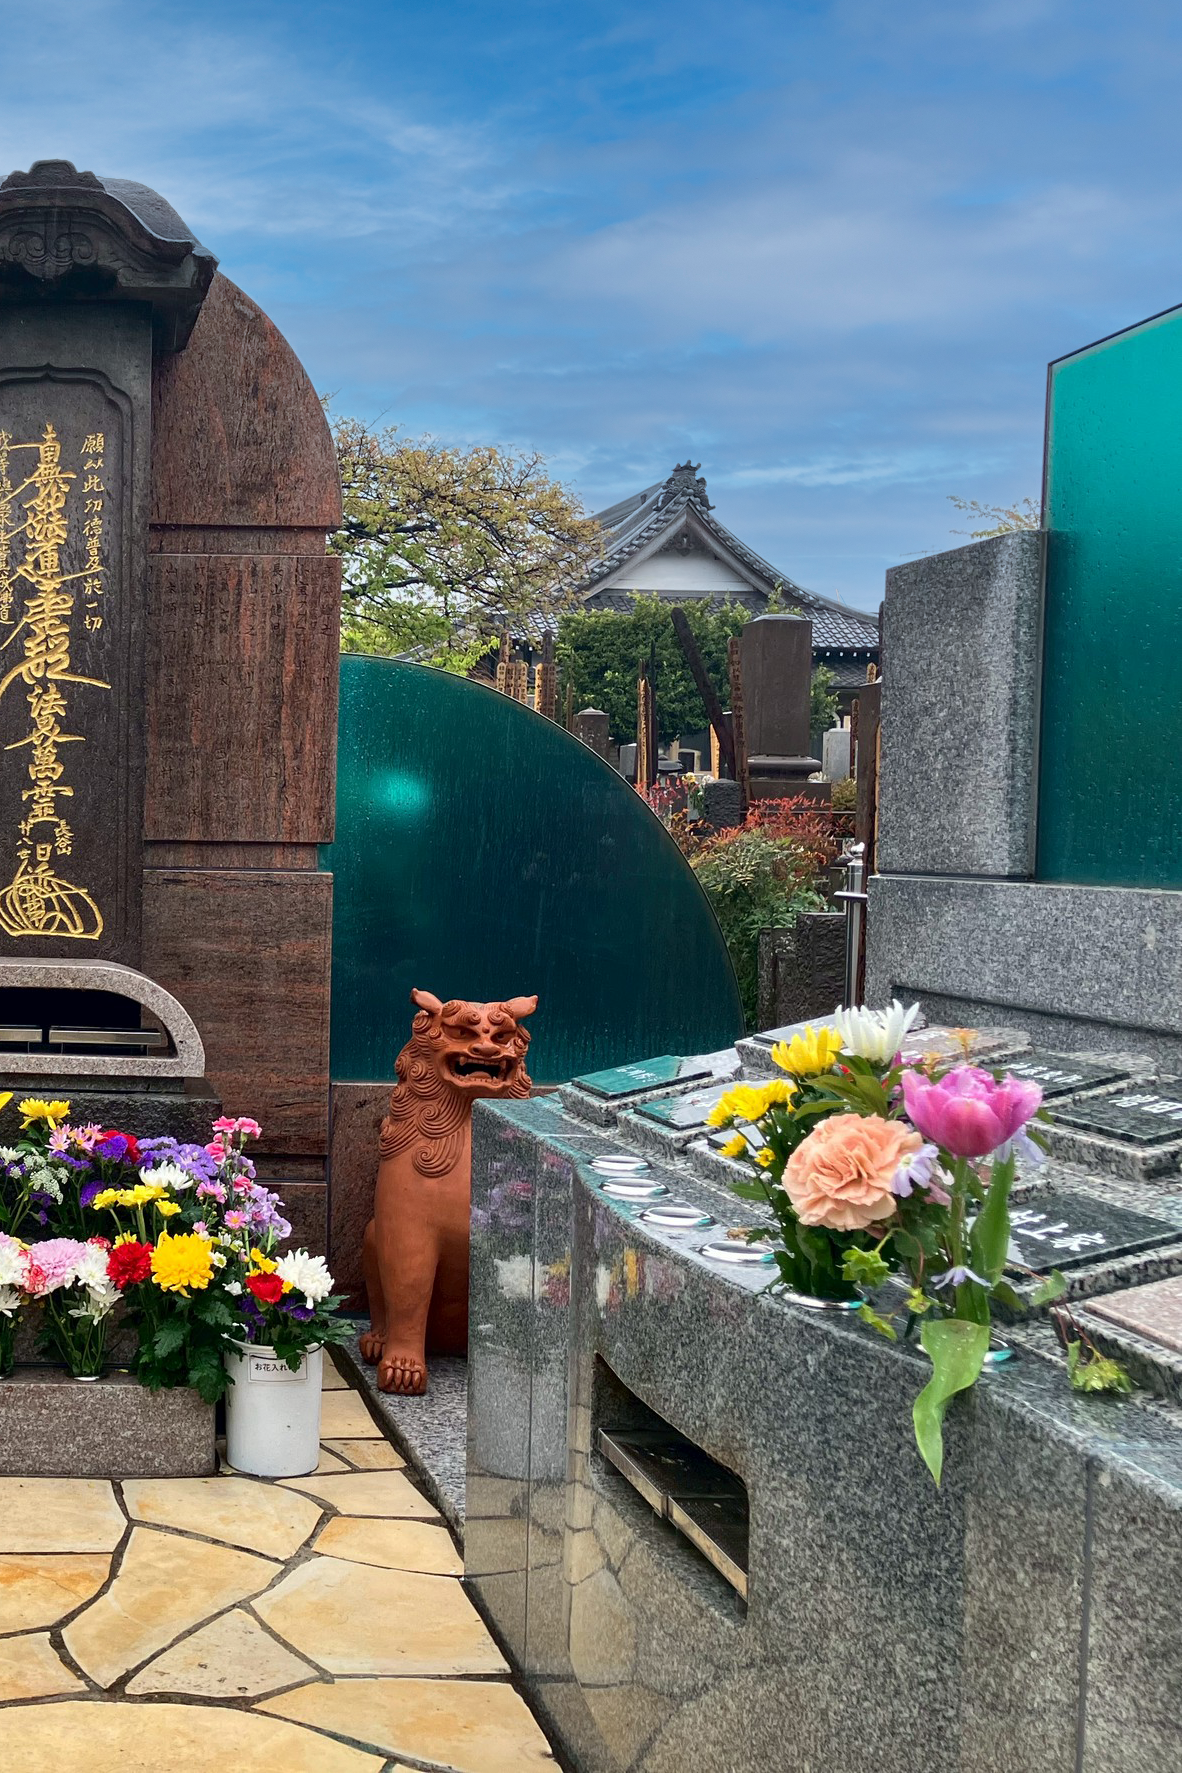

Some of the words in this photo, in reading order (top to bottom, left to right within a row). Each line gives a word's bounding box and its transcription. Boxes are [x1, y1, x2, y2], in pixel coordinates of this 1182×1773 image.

[1008, 1209, 1107, 1252] 村上家
[254, 1363, 289, 1372] お花入れ
